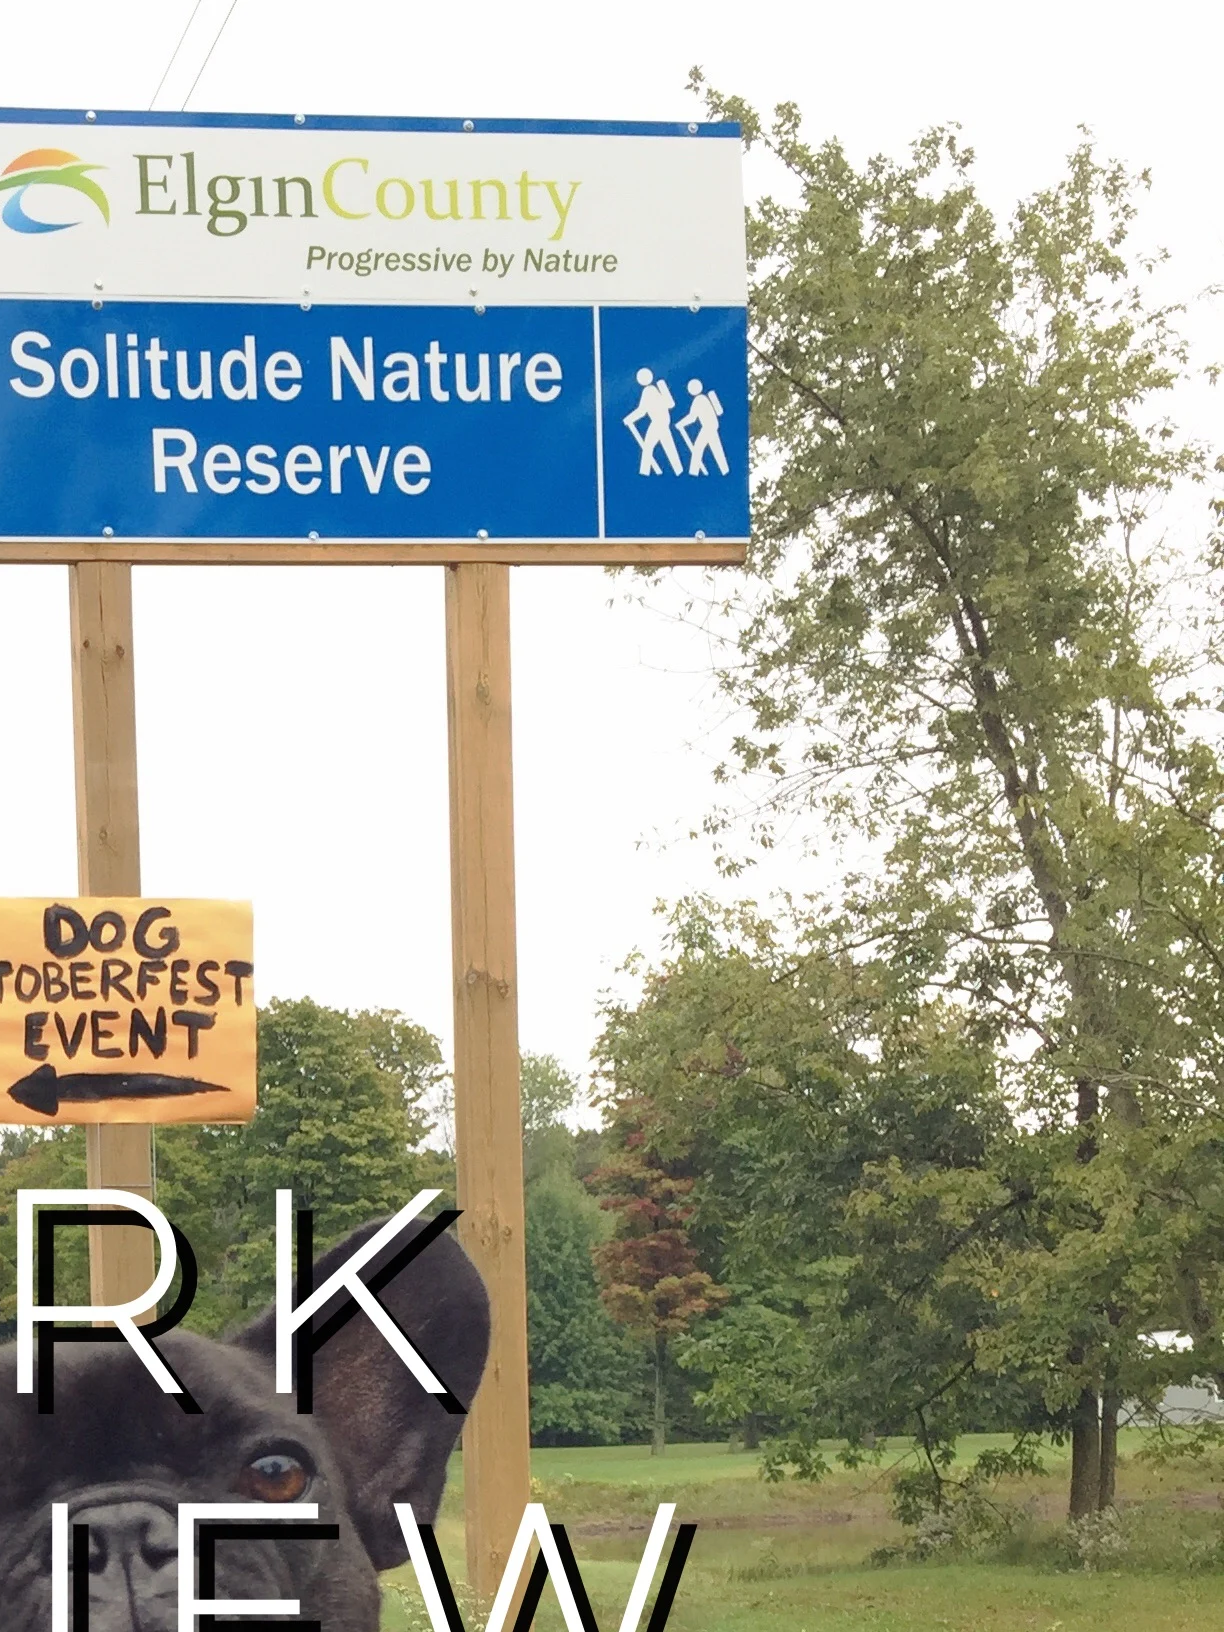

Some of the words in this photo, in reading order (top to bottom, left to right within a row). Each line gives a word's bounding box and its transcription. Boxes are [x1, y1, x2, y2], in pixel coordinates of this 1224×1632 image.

[306, 245, 473, 276] Progressive
[481, 247, 515, 277] by
[523, 247, 619, 273] Nature
[9, 330, 303, 401] Solitude
[330, 336, 563, 402] Nature
[152, 428, 432, 495] Reserve
[43, 904, 180, 959] DOG
[24, 1006, 218, 1061] EVENT
